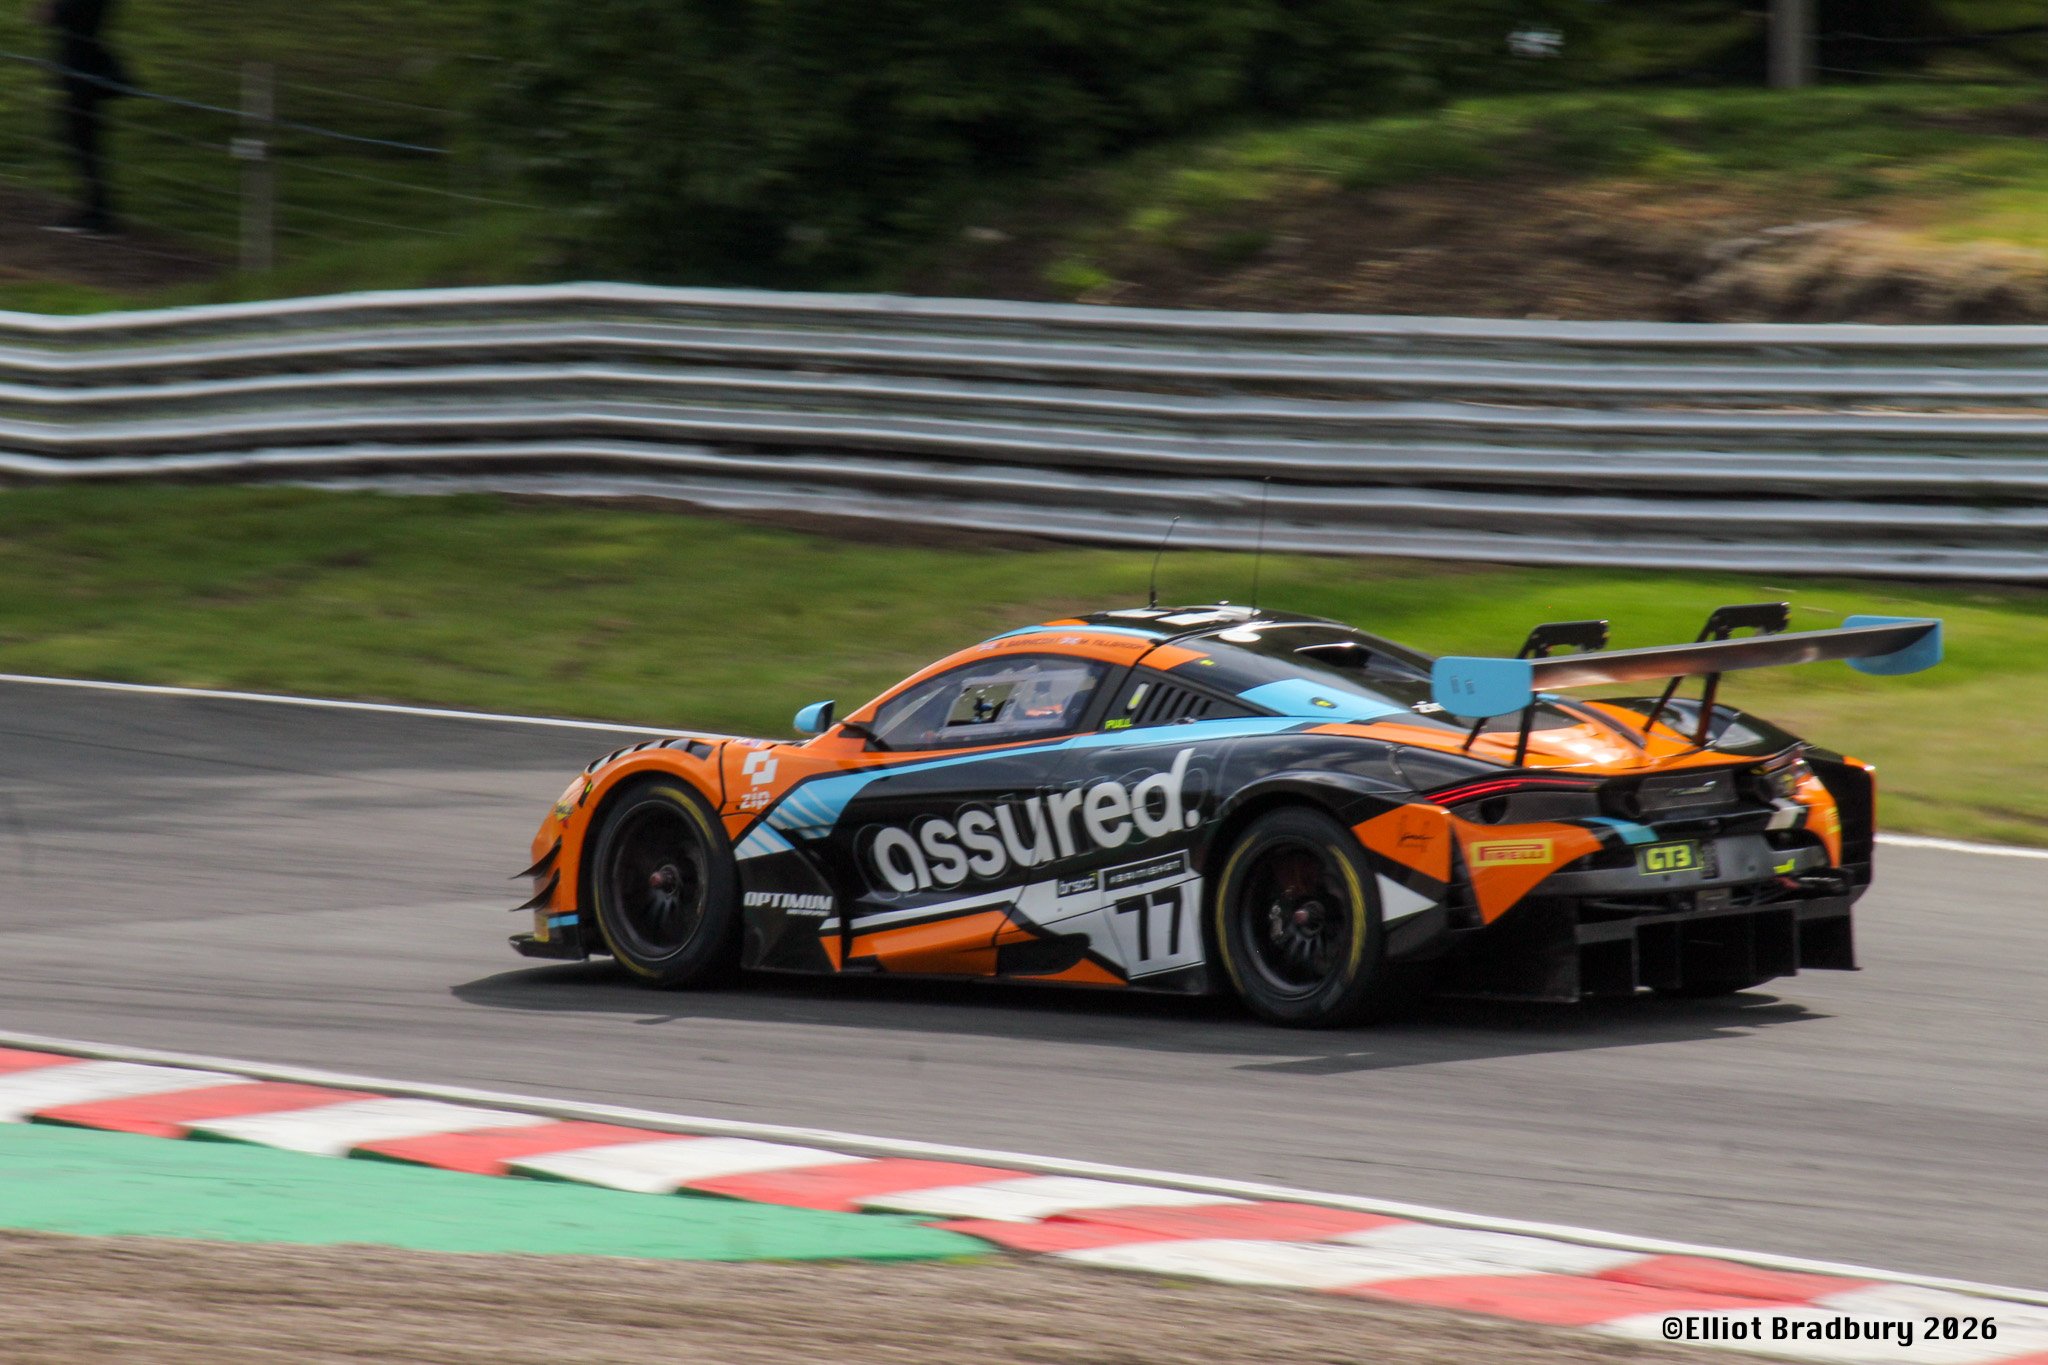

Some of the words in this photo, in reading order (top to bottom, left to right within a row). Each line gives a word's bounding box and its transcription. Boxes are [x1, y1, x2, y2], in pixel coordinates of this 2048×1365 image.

[1105, 718, 1133, 729] PULL
[740, 786, 770, 810] zip
[873, 748, 1200, 892] assured.
[1479, 844, 1545, 861] PIRELLI
[1646, 845, 1693, 870] GT3
[743, 891, 833, 910] OPTIMUM
[1115, 886, 1182, 962] 77
